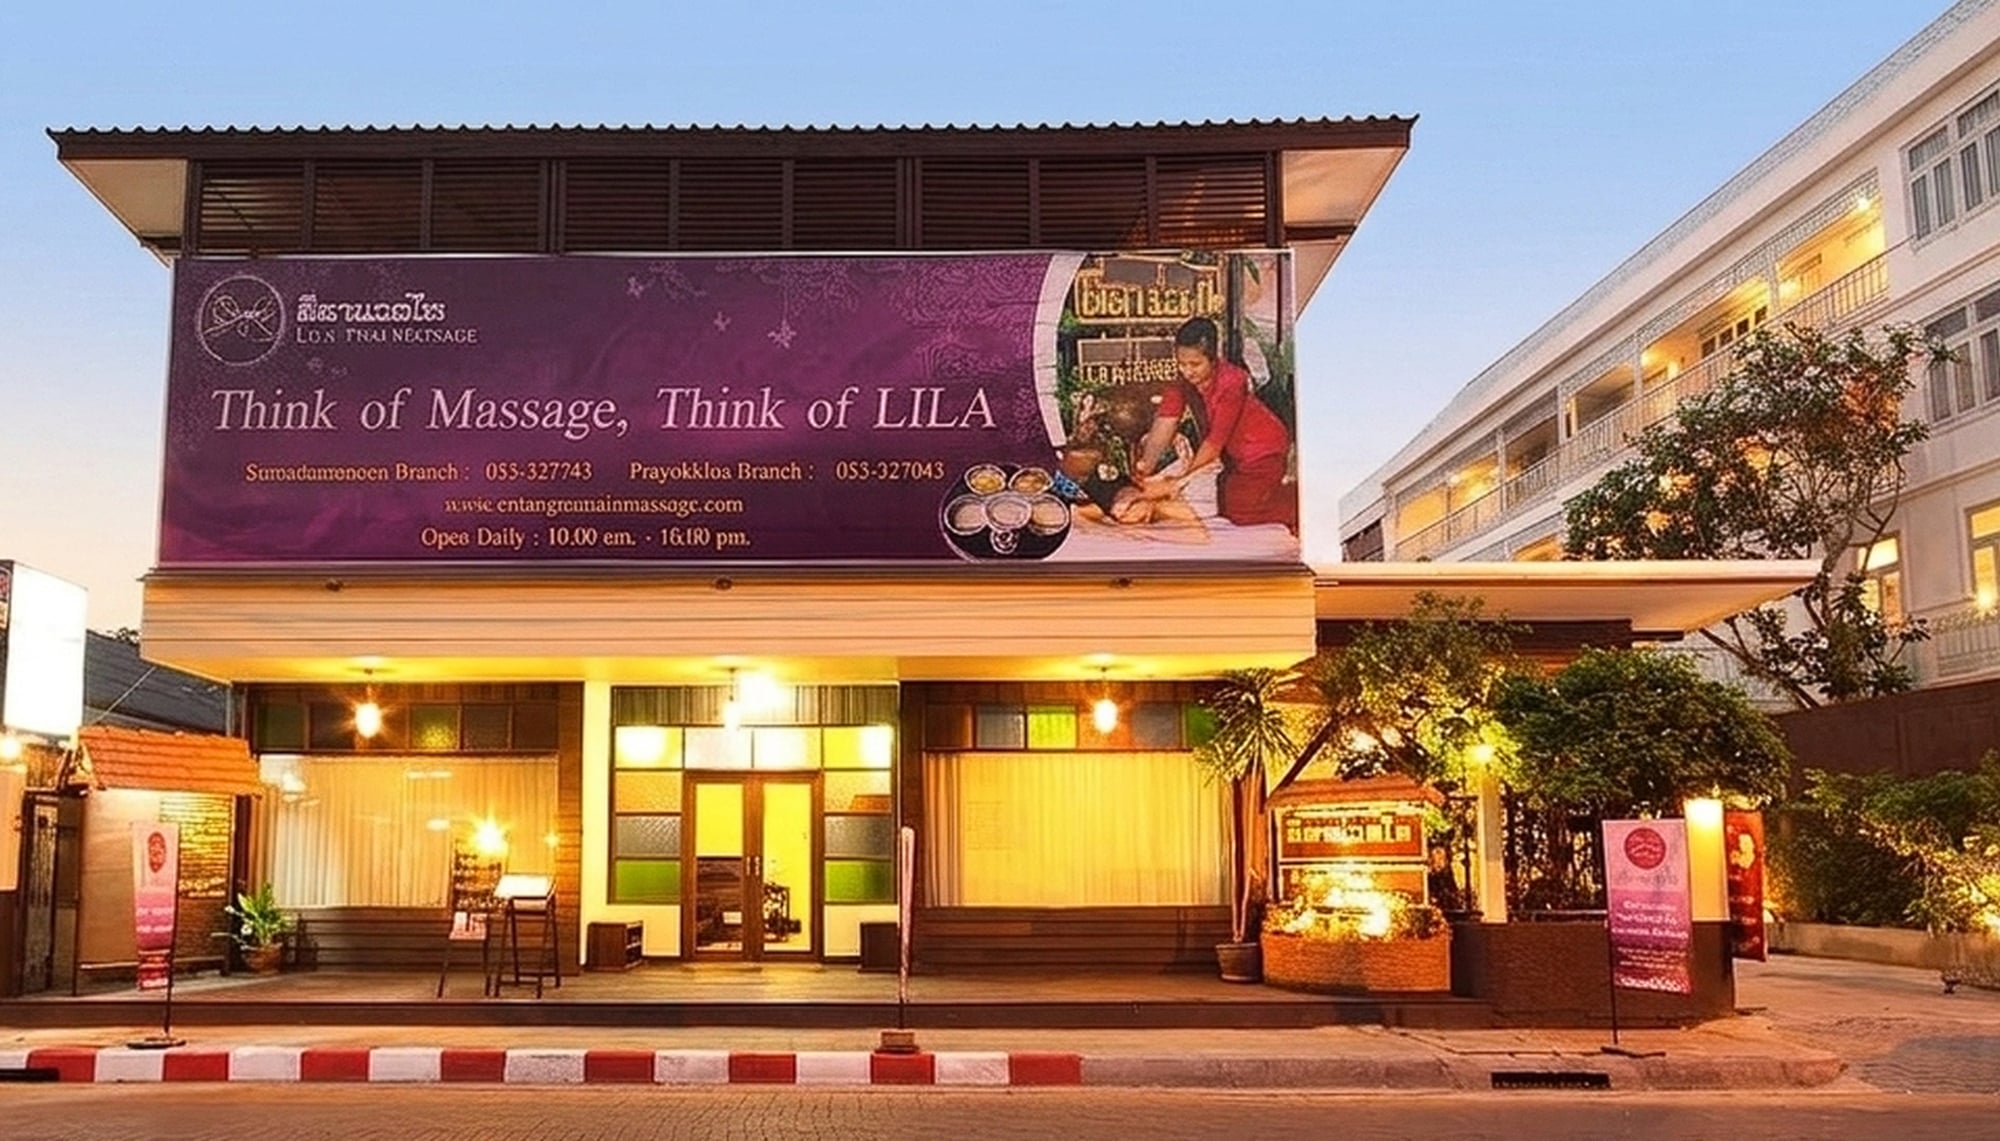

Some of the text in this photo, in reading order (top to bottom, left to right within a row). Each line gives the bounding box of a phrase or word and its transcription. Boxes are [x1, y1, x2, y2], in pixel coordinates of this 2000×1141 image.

[212, 387, 997, 440] Think of Massage, Think of LILA
[738, 461, 801, 480] Branch
[477, 527, 525, 550] Daily
